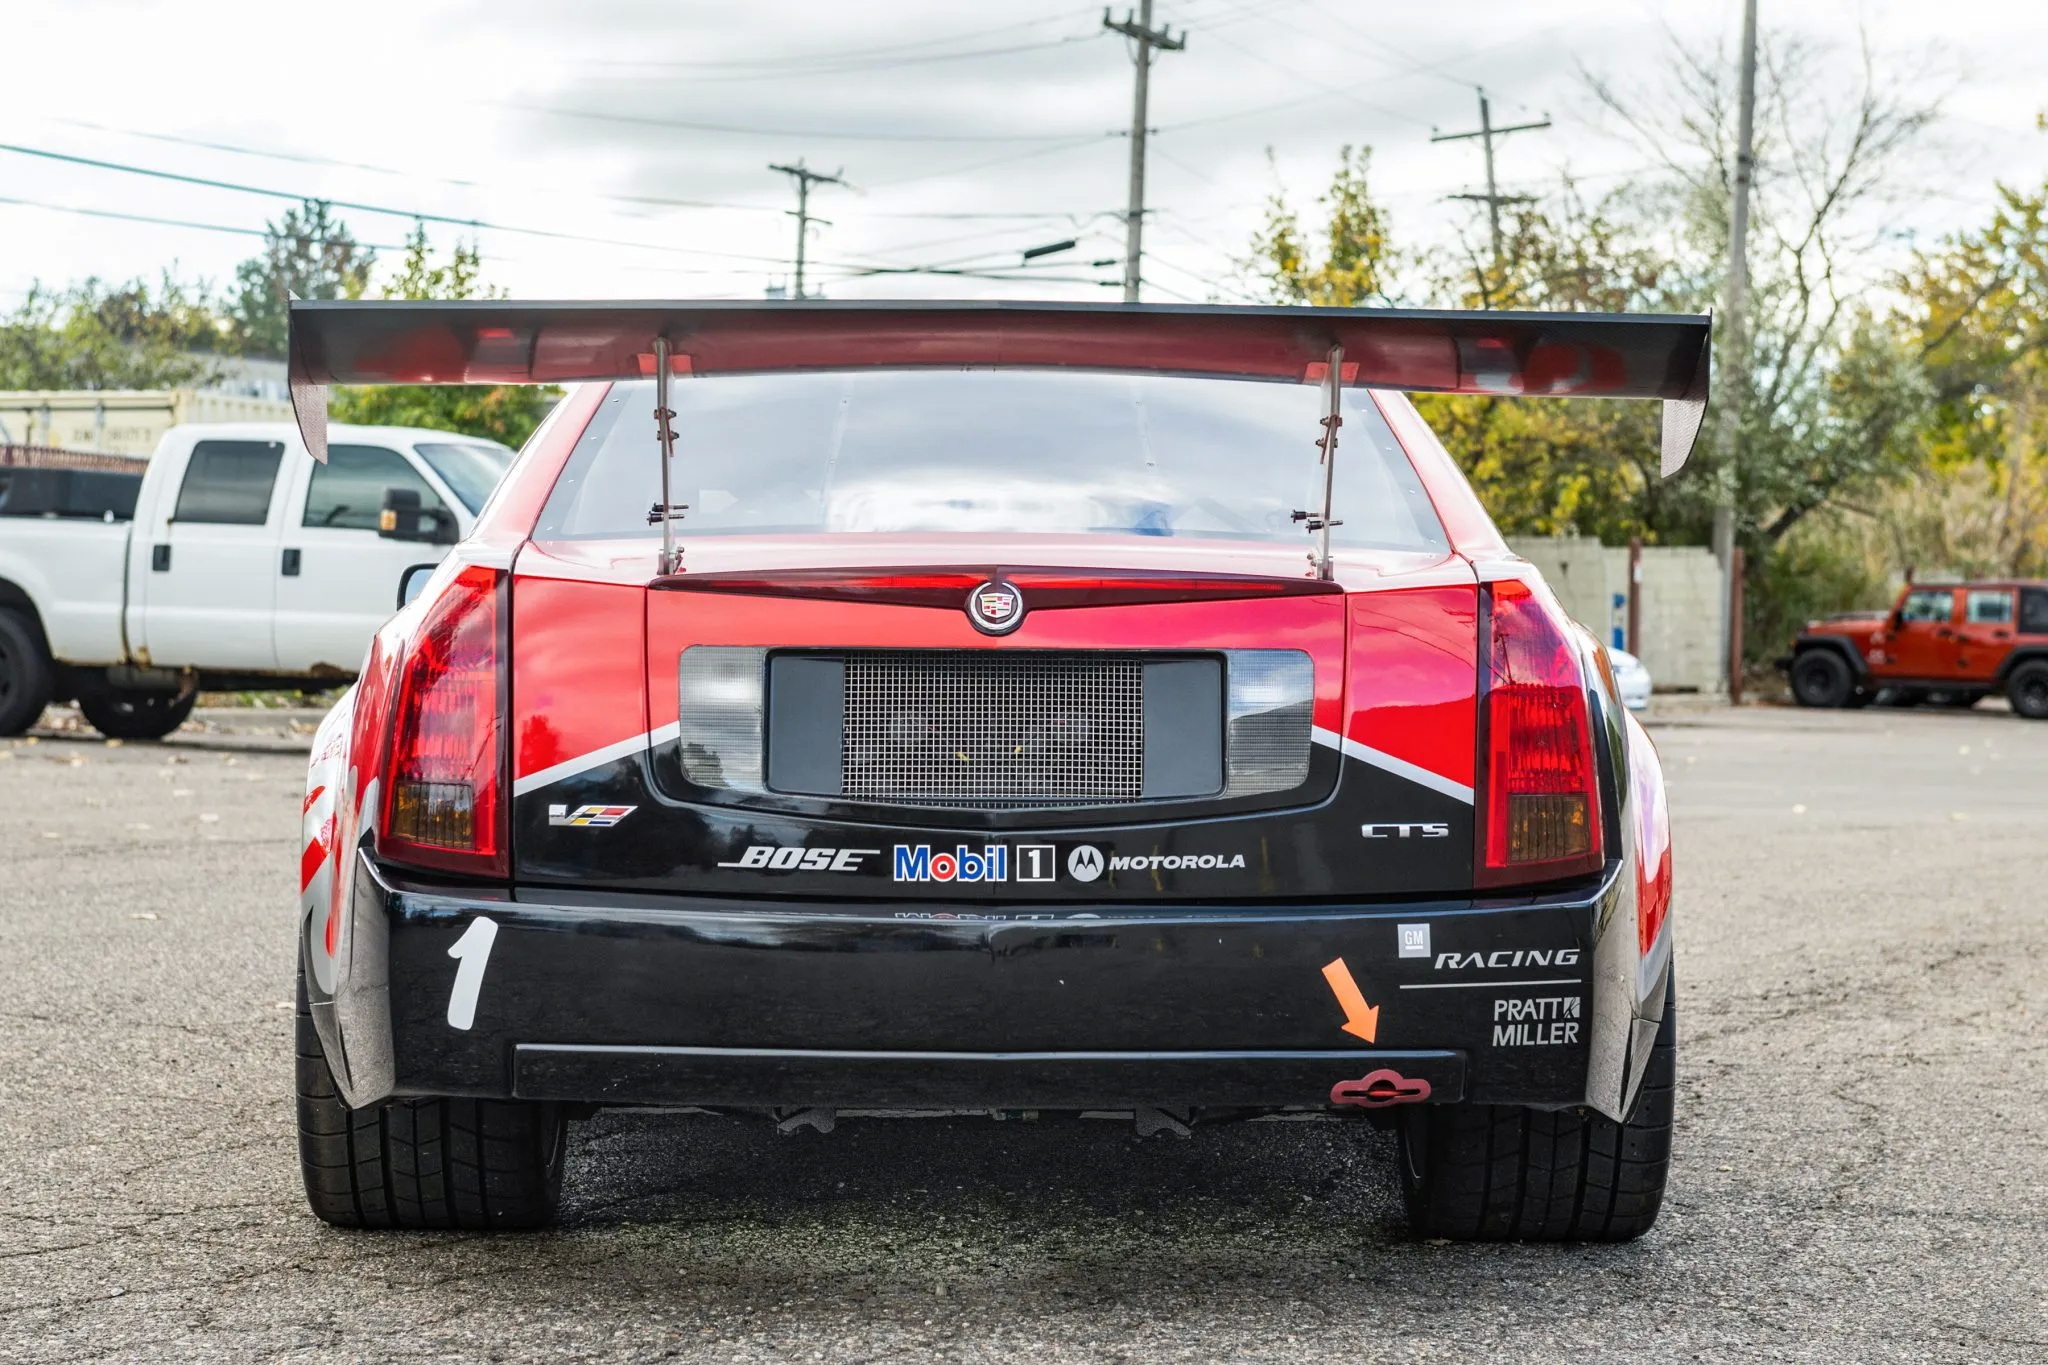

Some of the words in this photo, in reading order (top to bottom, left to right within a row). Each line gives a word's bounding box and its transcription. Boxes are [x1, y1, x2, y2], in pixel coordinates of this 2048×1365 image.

[1361, 823, 1449, 838] CTS
[718, 846, 881, 871] BOSE
[893, 844, 1008, 882] Mobil
[1108, 854, 1246, 871] MOTOROLA
[1404, 930, 1424, 945] GM
[1434, 949, 1581, 970] RACING
[447, 916, 499, 1031] 1
[1493, 998, 1562, 1021] PRATT
[1492, 1022, 1580, 1047] MILLER
